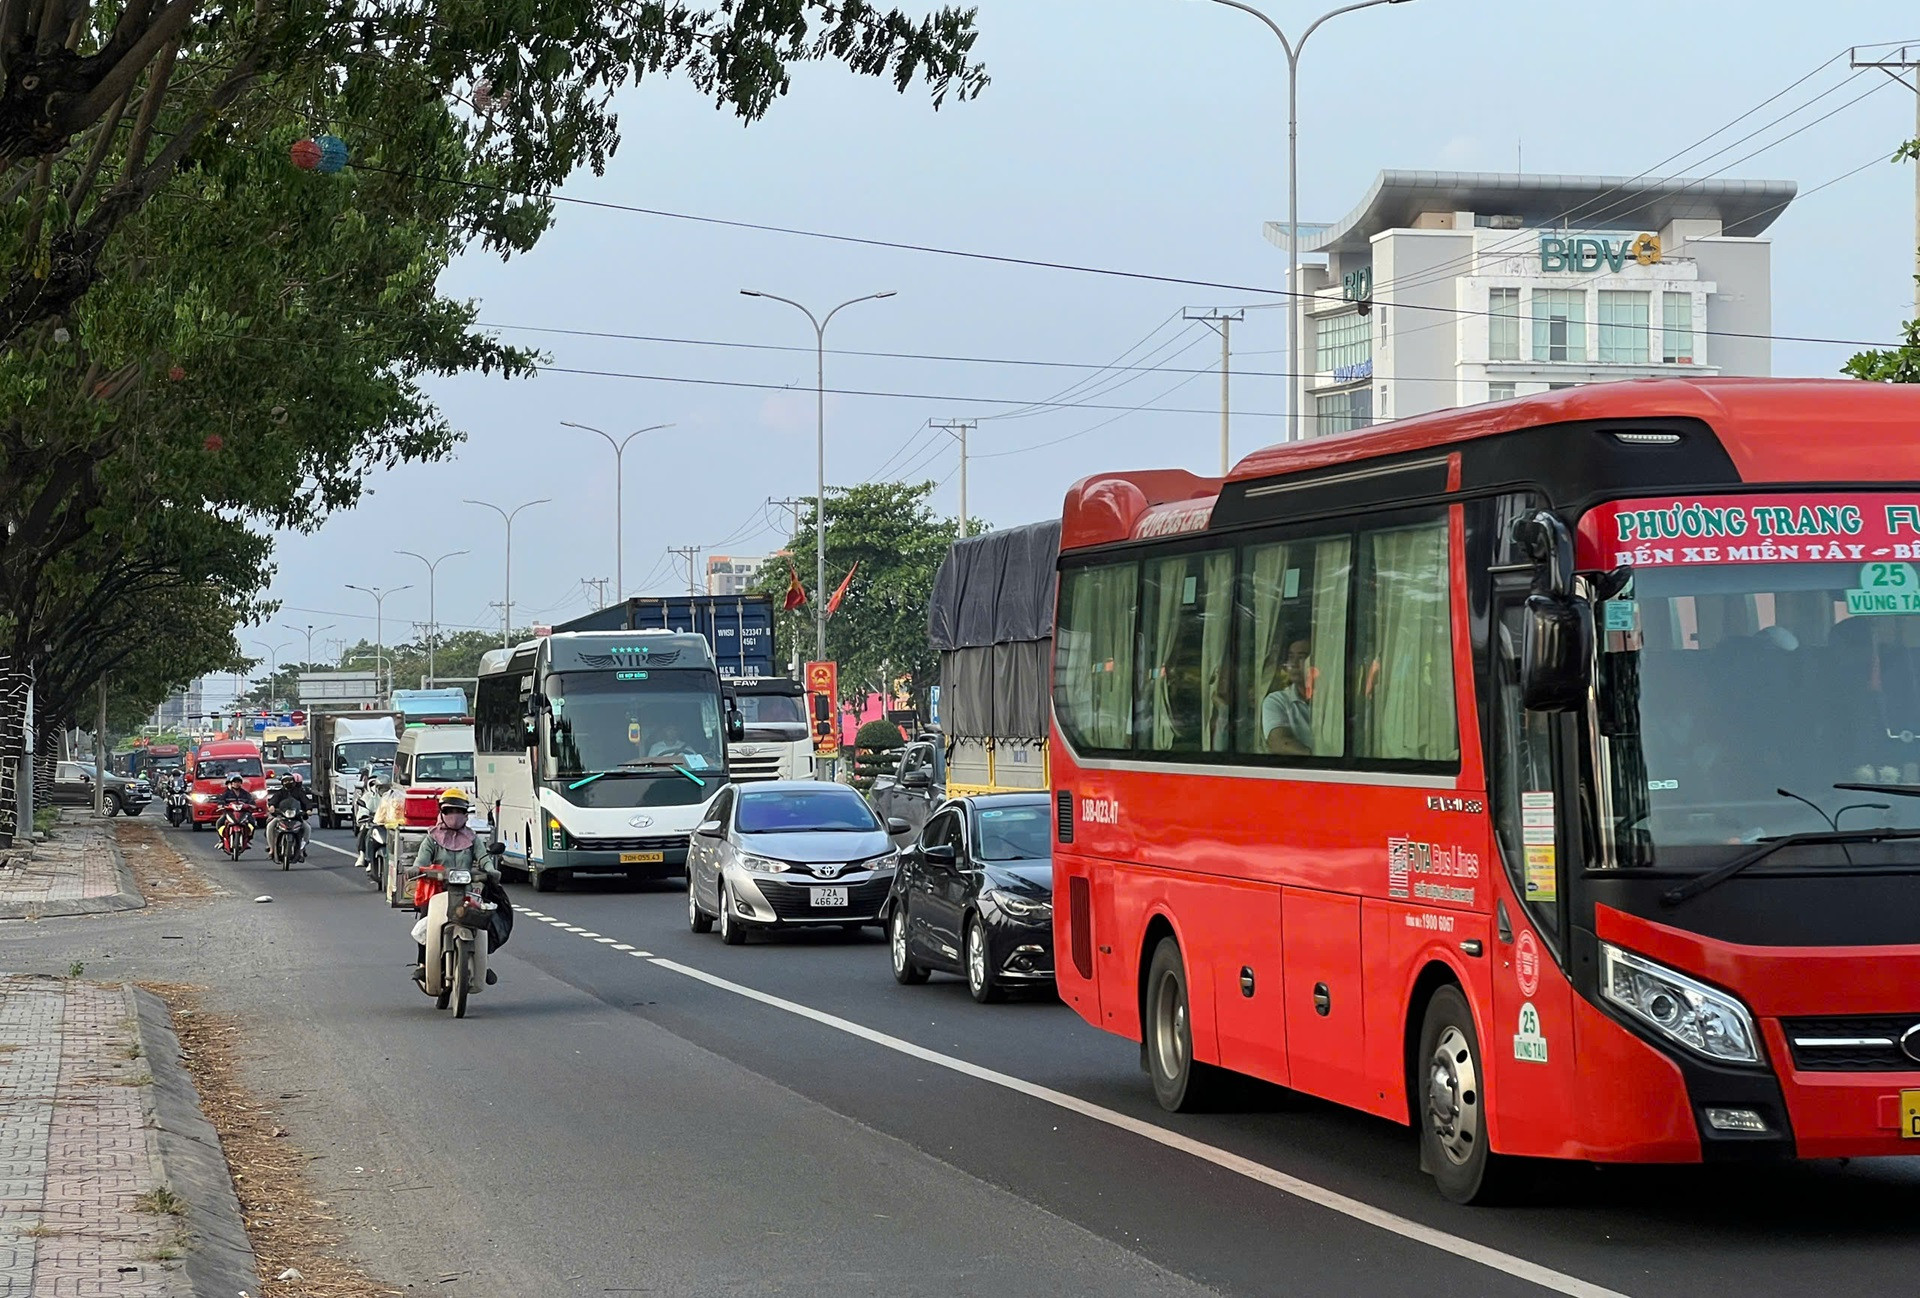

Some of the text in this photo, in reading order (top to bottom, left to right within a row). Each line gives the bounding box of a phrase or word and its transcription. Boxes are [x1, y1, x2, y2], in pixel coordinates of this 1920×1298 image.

[1541, 238, 1632, 273] BIDV
[1614, 502, 1748, 541] PHƯƠNG
[1751, 505, 1863, 536] TRANG
[1615, 543, 1674, 566] BẾN
[1681, 547, 1721, 562] XE
[1727, 538, 1799, 561] MIỀN
[1805, 540, 1865, 559] TÂY
[1871, 564, 1906, 586] 25
[1851, 590, 1897, 610] VŨNG
[717, 629, 735, 637] WHSU
[742, 628, 762, 636] 523347
[614, 655, 647, 667] VIP
[1422, 913, 1438, 930] 1900
[1523, 1010, 1536, 1033] 25
